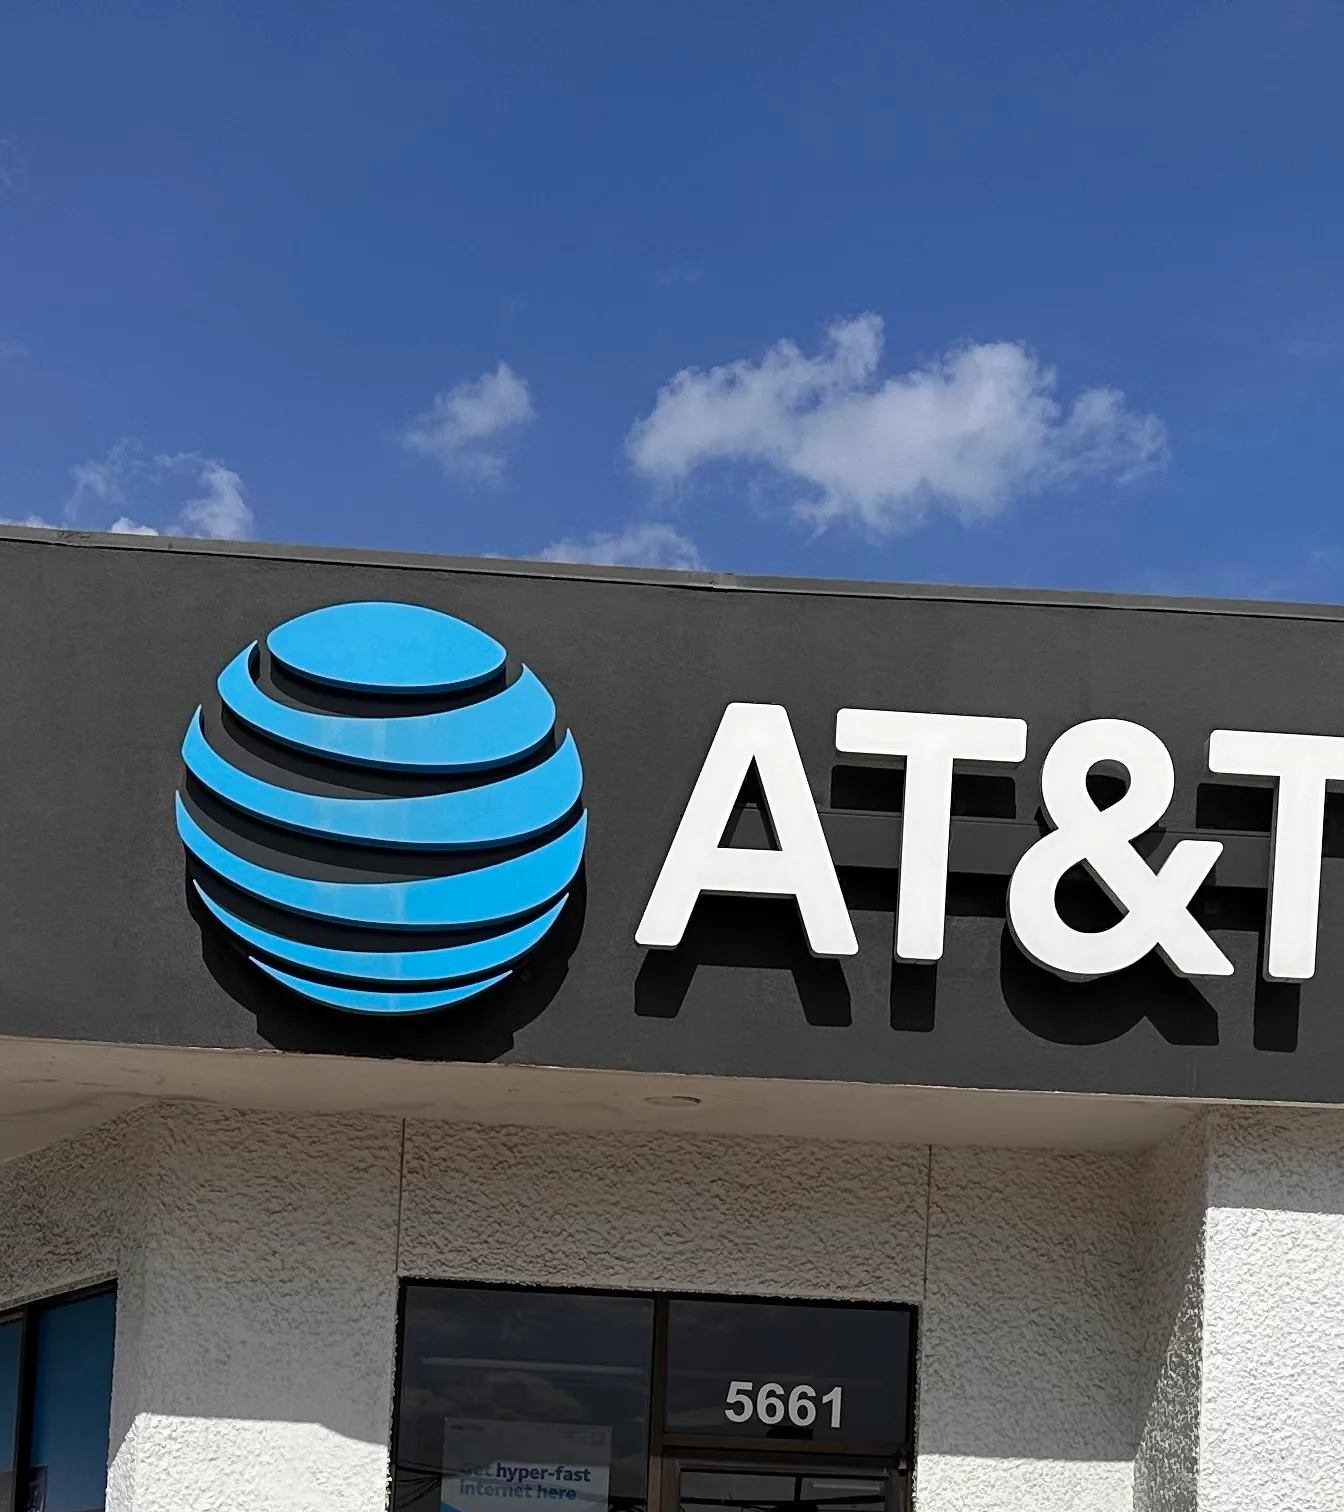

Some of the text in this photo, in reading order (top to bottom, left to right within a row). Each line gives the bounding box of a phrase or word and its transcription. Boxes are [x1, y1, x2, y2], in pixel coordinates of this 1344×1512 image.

[724, 1380, 842, 1429] 5661
[496, 1462, 592, 1483] hyper-fast
[460, 1479, 577, 1501] internet here
